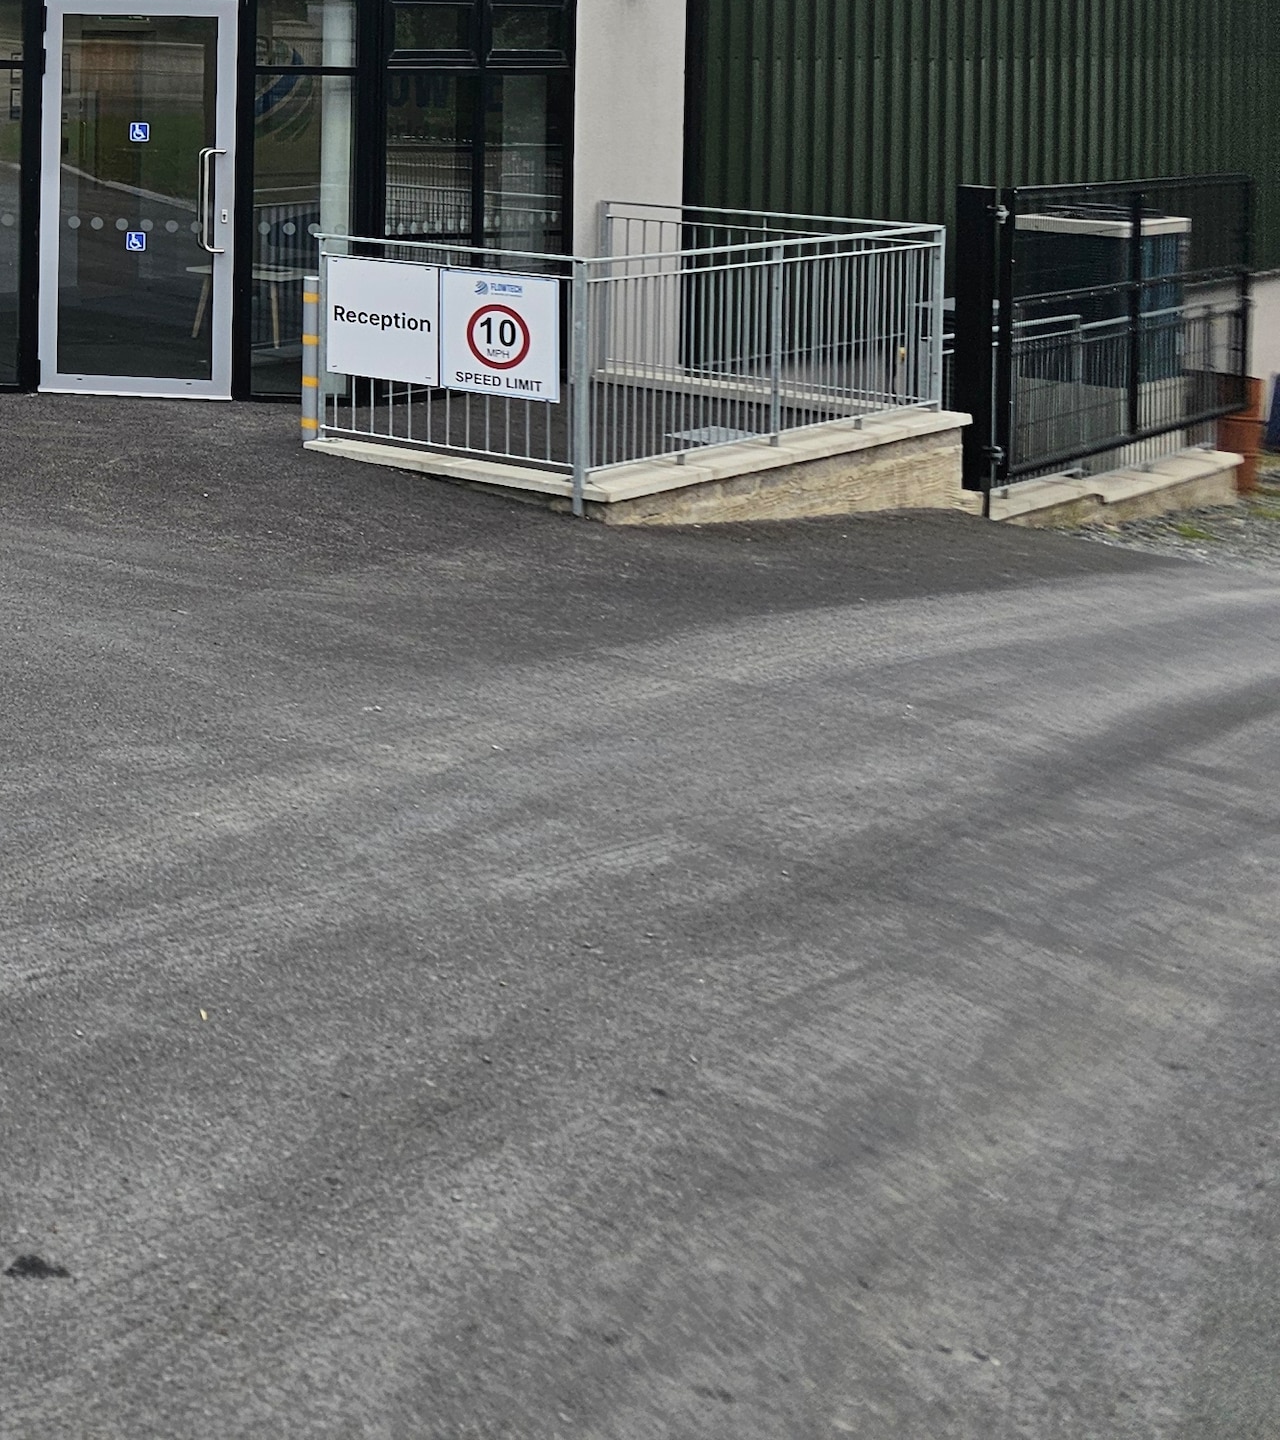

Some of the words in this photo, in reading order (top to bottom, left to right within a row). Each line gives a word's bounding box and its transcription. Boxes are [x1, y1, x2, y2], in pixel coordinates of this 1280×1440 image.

[334, 305, 431, 332] Reception
[480, 317, 517, 347] 10
[486, 348, 510, 359] MPH
[455, 371, 501, 387] SPEED
[506, 378, 543, 392] LIMIT
